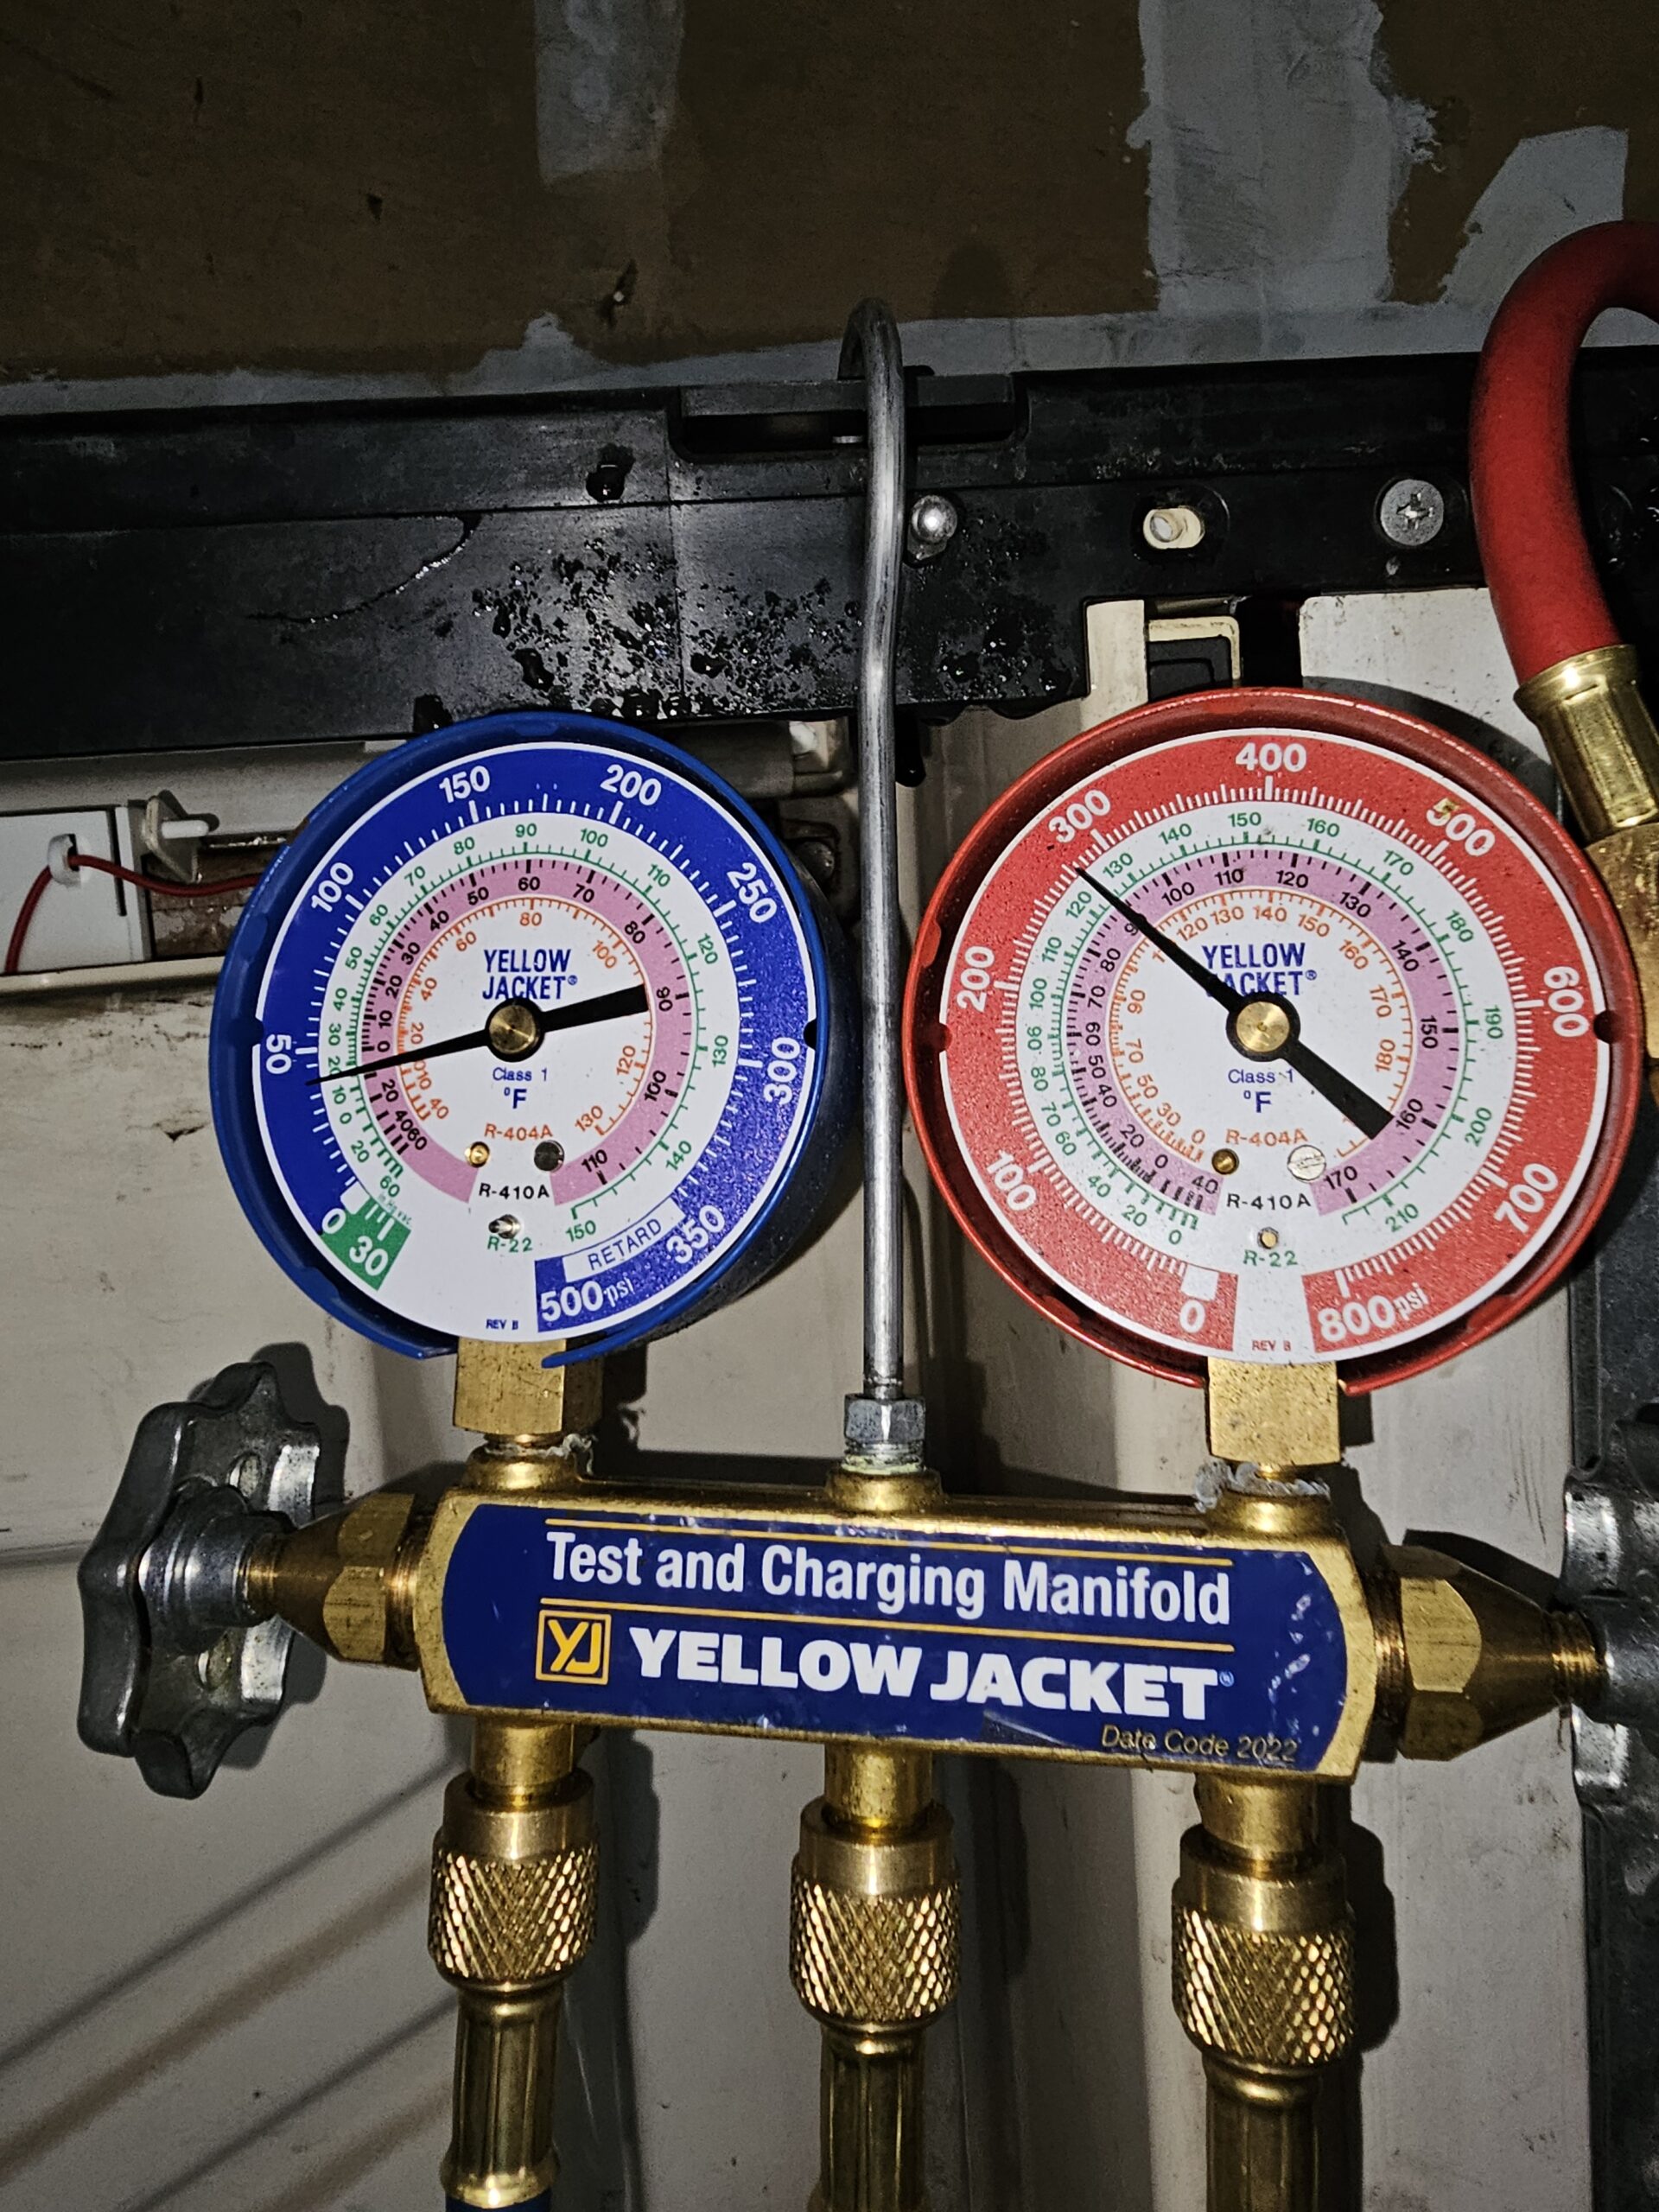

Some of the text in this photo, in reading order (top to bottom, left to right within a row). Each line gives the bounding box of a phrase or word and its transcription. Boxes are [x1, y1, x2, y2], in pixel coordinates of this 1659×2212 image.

[1235, 742, 1307, 772] 400
[439, 766, 490, 803] 150
[600, 764, 662, 806] 200
[1048, 789, 1111, 843] 300
[1228, 811, 1262, 828] 150
[1306, 817, 1340, 837] 160
[1426, 798, 1496, 856] 500
[515, 823, 537, 838] 90
[580, 828, 608, 848] 100
[1159, 823, 1192, 845] 140
[453, 836, 475, 855] 80
[1102, 853, 1134, 879] 130
[1382, 849, 1414, 875] 170
[311, 862, 354, 912] 100
[404, 865, 426, 887] 70
[518, 876, 541, 891] 60
[647, 863, 671, 887] 110
[1214, 868, 1244, 886] 110
[1276, 870, 1309, 888] 120
[467, 887, 490, 906] 50
[572, 883, 594, 903] 70
[727, 862, 777, 924] 250
[1065, 891, 1092, 918] 120
[1160, 881, 1195, 906] 100
[1338, 892, 1371, 918] 130
[369, 904, 389, 927] 60
[429, 910, 450, 932] 40
[519, 912, 542, 926] 80
[1211, 906, 1244, 925] 130
[1253, 906, 1287, 922] 140
[1297, 913, 1330, 938] 150
[1446, 910, 1474, 943] 180
[455, 931, 477, 952] 60
[624, 921, 645, 944] 80
[1176, 917, 1209, 941] 120
[345, 945, 363, 970] 50
[401, 942, 421, 965] 30
[484, 949, 571, 973] YELLOW
[593, 940, 617, 969] 100
[697, 932, 718, 965] 120
[1041, 937, 1062, 963] 110
[1100, 948, 1122, 973] 80
[1201, 942, 1306, 969] YELLOW
[1338, 938, 1369, 969] 160
[1391, 939, 1420, 972] 140
[385, 975, 404, 1000] 20
[421, 977, 438, 1001] 40
[956, 945, 995, 1013] 200
[333, 988, 347, 1012] 40
[656, 986, 673, 1012] 90
[1029, 977, 1047, 1010] 100
[1087, 985, 1106, 1010] 70
[1127, 989, 1146, 1014] 90
[1370, 984, 1392, 1018] 170
[1543, 965, 1590, 1038] 600
[378, 1010, 392, 1029] 10
[1420, 1014, 1438, 1050] 150
[1484, 1005, 1504, 1039] 190
[327, 1022, 341, 1046] 30
[377, 1040, 391, 1052] 0
[410, 1022, 424, 1045] 20
[1027, 1026, 1043, 1051] 90
[1085, 1021, 1101, 1046] 60
[266, 1033, 292, 1074] 50
[616, 1045, 636, 1076] 120
[712, 1034, 728, 1068] 130
[1125, 1039, 1144, 1064] 70
[1374, 1039, 1395, 1072] 180
[493, 1067, 548, 1081] Class 1
[762, 1036, 800, 1105] 300
[1030, 1066, 1049, 1091] 80
[1088, 1054, 1106, 1079] 50
[1228, 1069, 1294, 1084] Class 1
[382, 1078, 398, 1103] 20
[417, 1071, 432, 1090] 10
[644, 1070, 667, 1102] 100
[1136, 1074, 1159, 1099] 50
[332, 1085, 346, 1105] 10
[1098, 1084, 1117, 1108] 40
[339, 1112, 353, 1125] 0
[395, 1110, 413, 1132] 40
[429, 1097, 449, 1120] 40
[575, 1105, 603, 1133] 130
[1041, 1102, 1061, 1127] 70
[1156, 1102, 1181, 1127] 30
[1395, 1098, 1424, 1130] 160
[408, 1128, 428, 1151] 60
[484, 1123, 553, 1141] R-404A
[1120, 1124, 1145, 1148] 20
[1191, 1129, 1205, 1144] 0
[1225, 1128, 1308, 1147] R-404A
[1465, 1107, 1492, 1147] 200
[350, 1140, 370, 1162] 20
[665, 1140, 692, 1171] 140
[1055, 1131, 1077, 1156] 60
[581, 1149, 608, 1173] 110
[1154, 1154, 1169, 1169] 0
[380, 1175, 400, 1198] 60
[986, 1149, 1037, 1211] 100
[1087, 1175, 1111, 1198] 40
[1192, 1175, 1219, 1195] 40
[1324, 1166, 1358, 1190] 170
[479, 1182, 550, 1200] R-410A
[1227, 1193, 1312, 1211] R-410A
[1493, 1163, 1558, 1234] 700
[321, 1208, 346, 1235] 0
[1122, 1205, 1147, 1227] 20
[1384, 1203, 1420, 1232] 210
[565, 1219, 596, 1243] 150
[666, 1205, 725, 1264] 350
[1168, 1230, 1182, 1245] 0
[349, 1236, 388, 1276] 30
[487, 1236, 533, 1252] R-22
[588, 1218, 662, 1271] RETARD
[1243, 1249, 1298, 1268] R-22
[486, 1319, 519, 1330] REV B
[1179, 1300, 1206, 1333] 0
[1252, 1340, 1292, 1351] REV B
[546, 1531, 1230, 1625] Test and Charging Manifold
[547, 1618, 602, 1675] YJ
[629, 1626, 923, 1698] YELLOW
[1102, 1724, 1297, 1762] Date Code 2022
